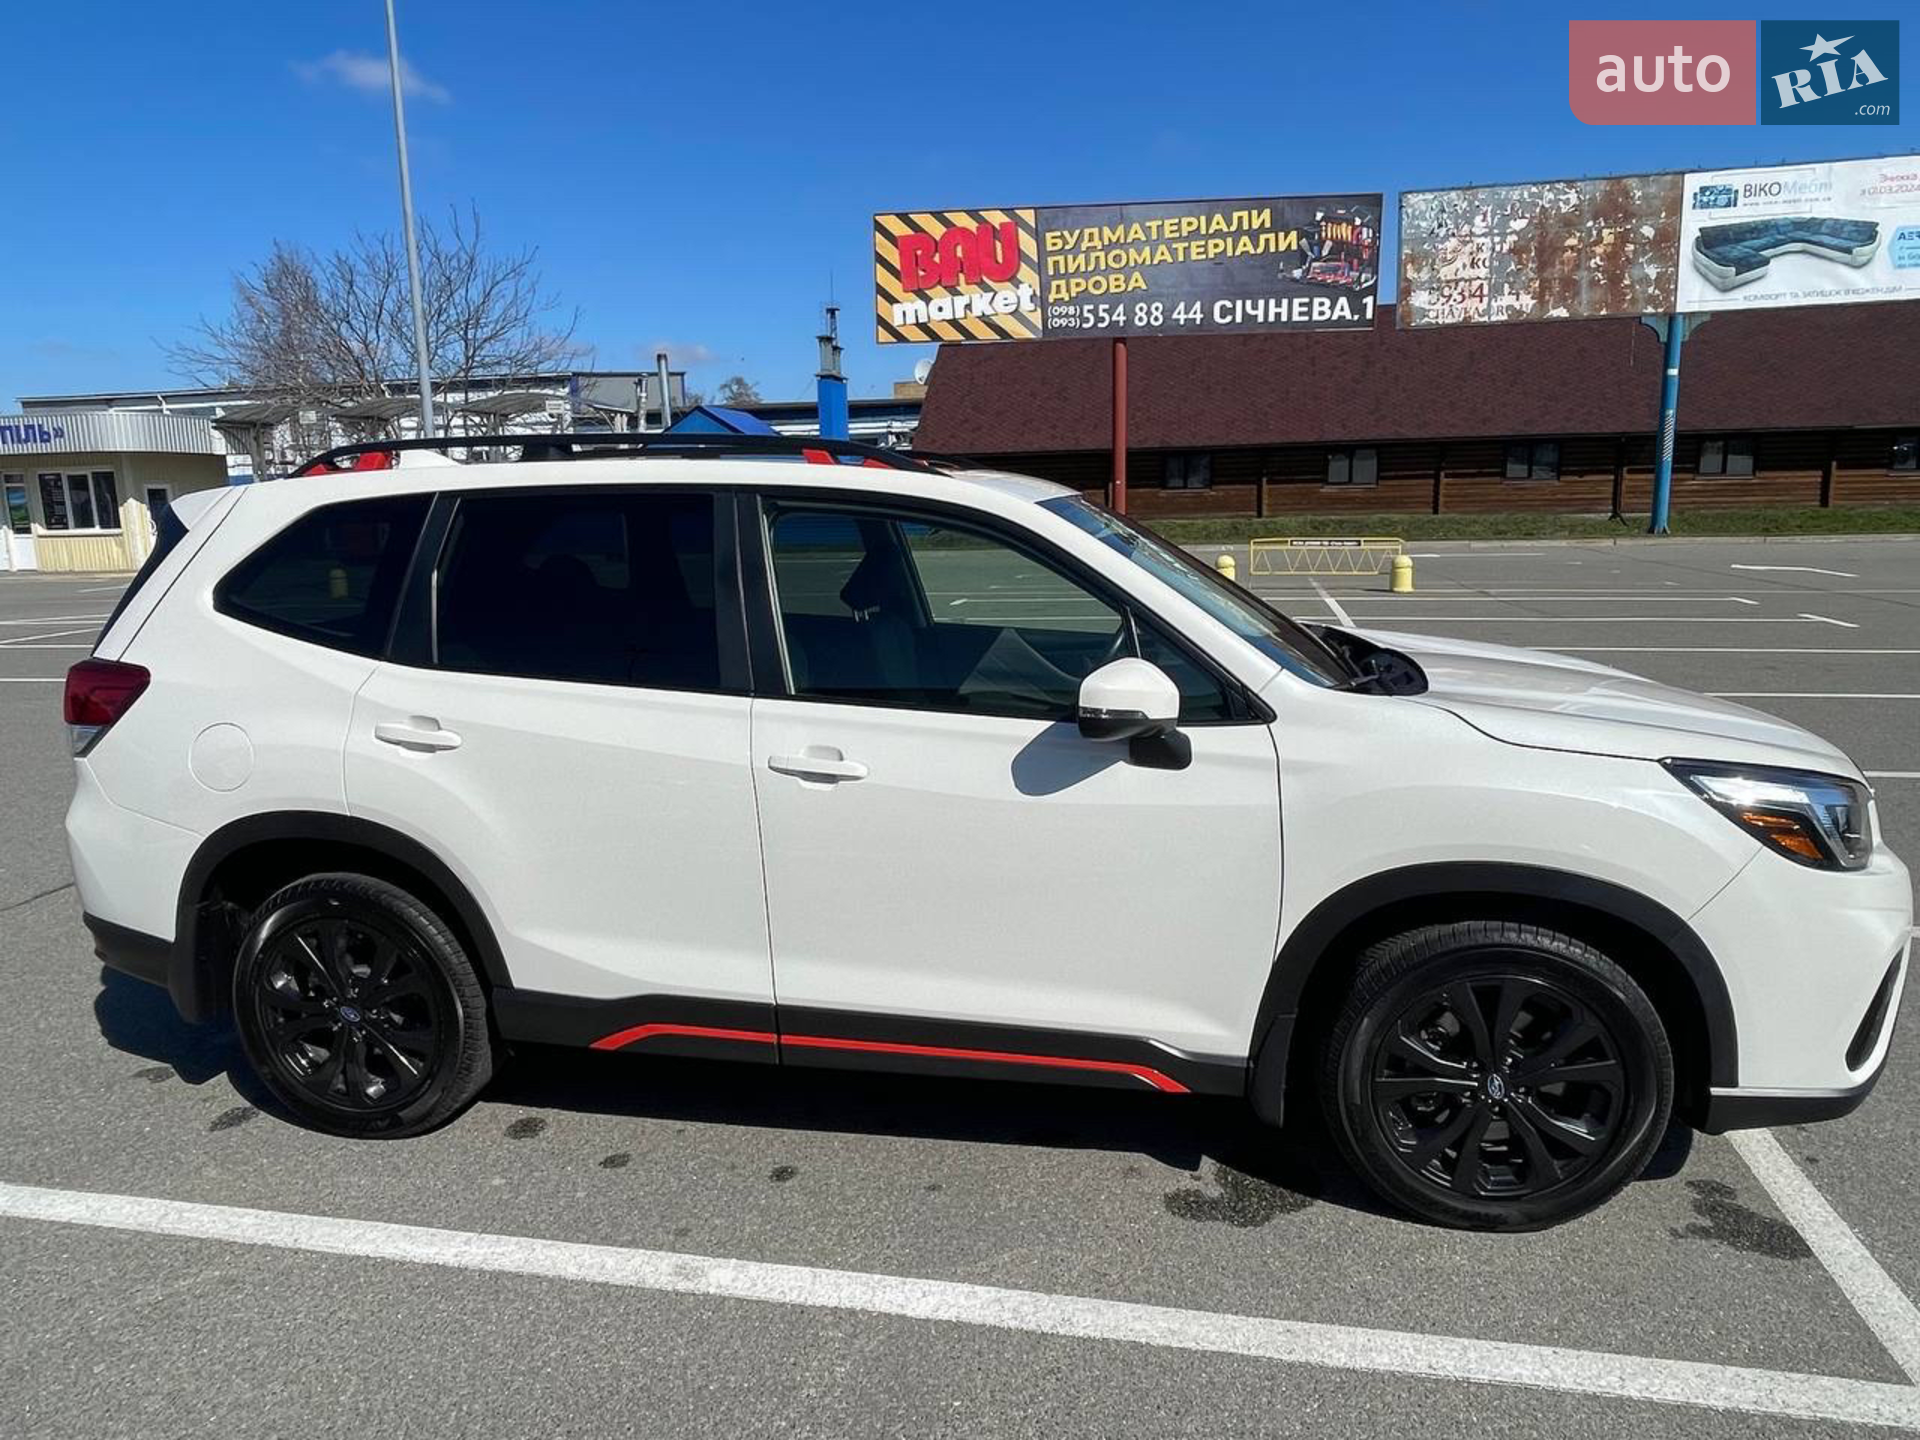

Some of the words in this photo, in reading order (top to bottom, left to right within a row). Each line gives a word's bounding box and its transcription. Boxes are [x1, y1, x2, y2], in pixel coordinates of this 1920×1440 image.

[1045, 208, 1273, 252] БУДМАТЕРІАЛИ
[897, 222, 1020, 293] BAU
[1046, 230, 1299, 276] ПИЛОМАТЕРІАЛИ
[892, 283, 1036, 327] market
[1048, 271, 1148, 303] ДРОВА
[1047, 305, 1081, 317] (098)
[1047, 317, 1081, 329] (093)
[1081, 303, 1127, 329] 554
[1133, 302, 1164, 327] 88
[1171, 300, 1205, 326] 44
